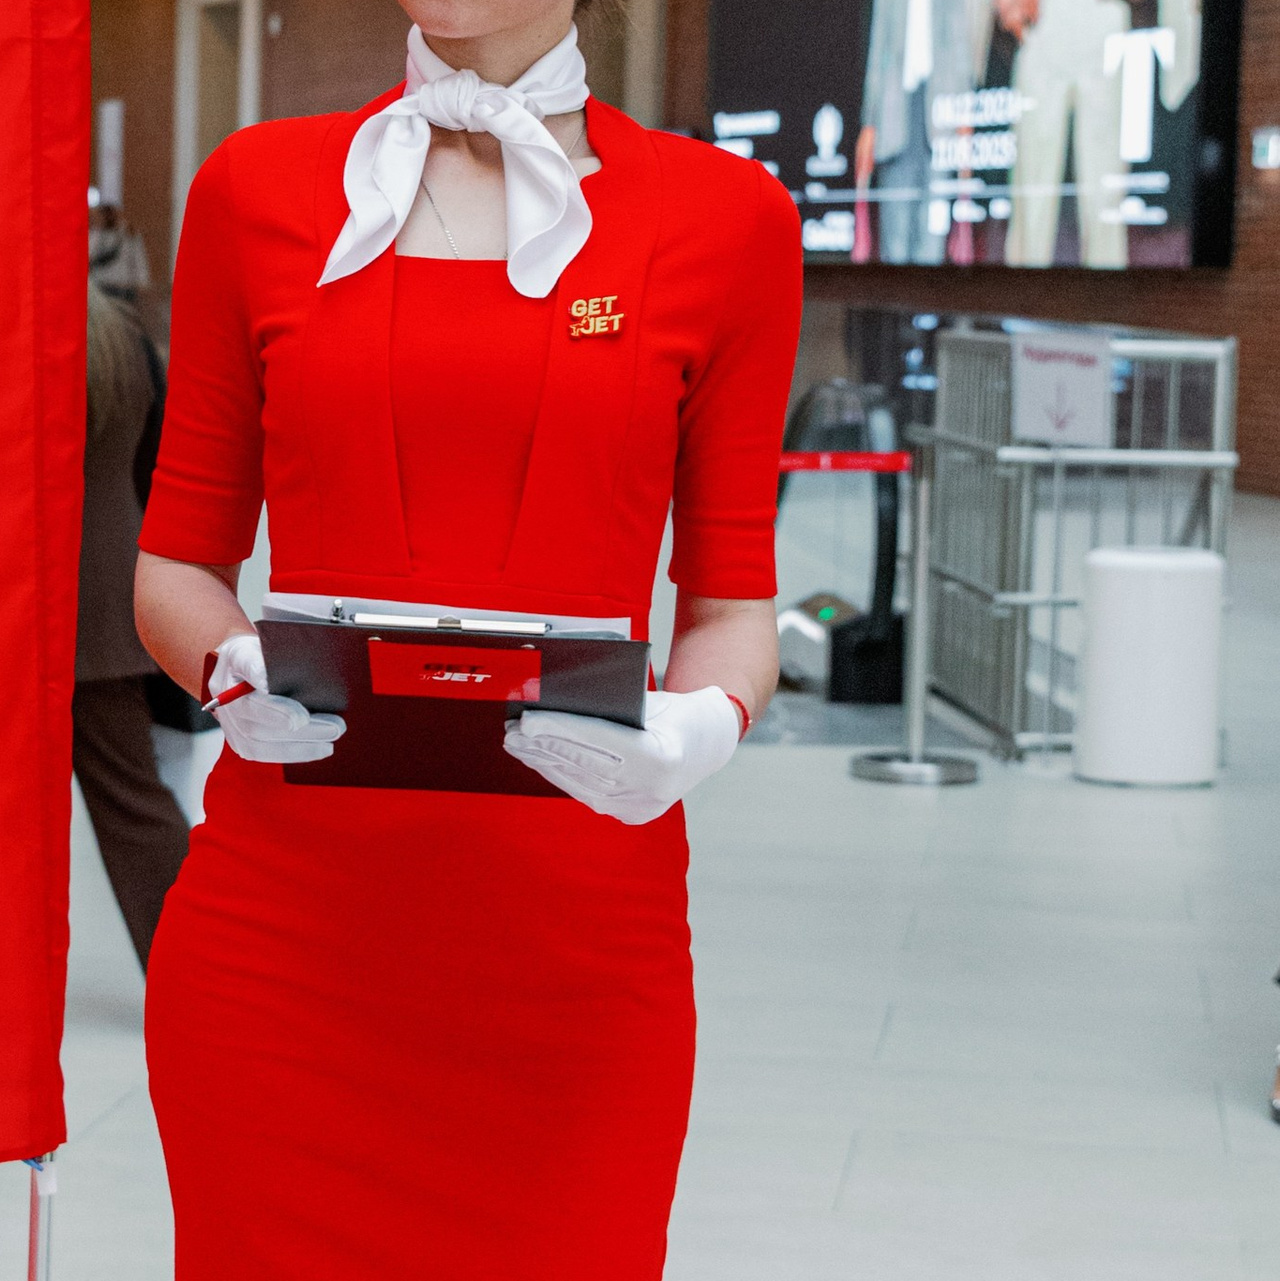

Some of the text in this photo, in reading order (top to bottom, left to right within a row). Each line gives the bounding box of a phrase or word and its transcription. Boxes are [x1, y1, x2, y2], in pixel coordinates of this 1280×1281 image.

[571, 295, 618, 318] GET
[580, 313, 624, 335] JET
[432, 672, 492, 683] JET
